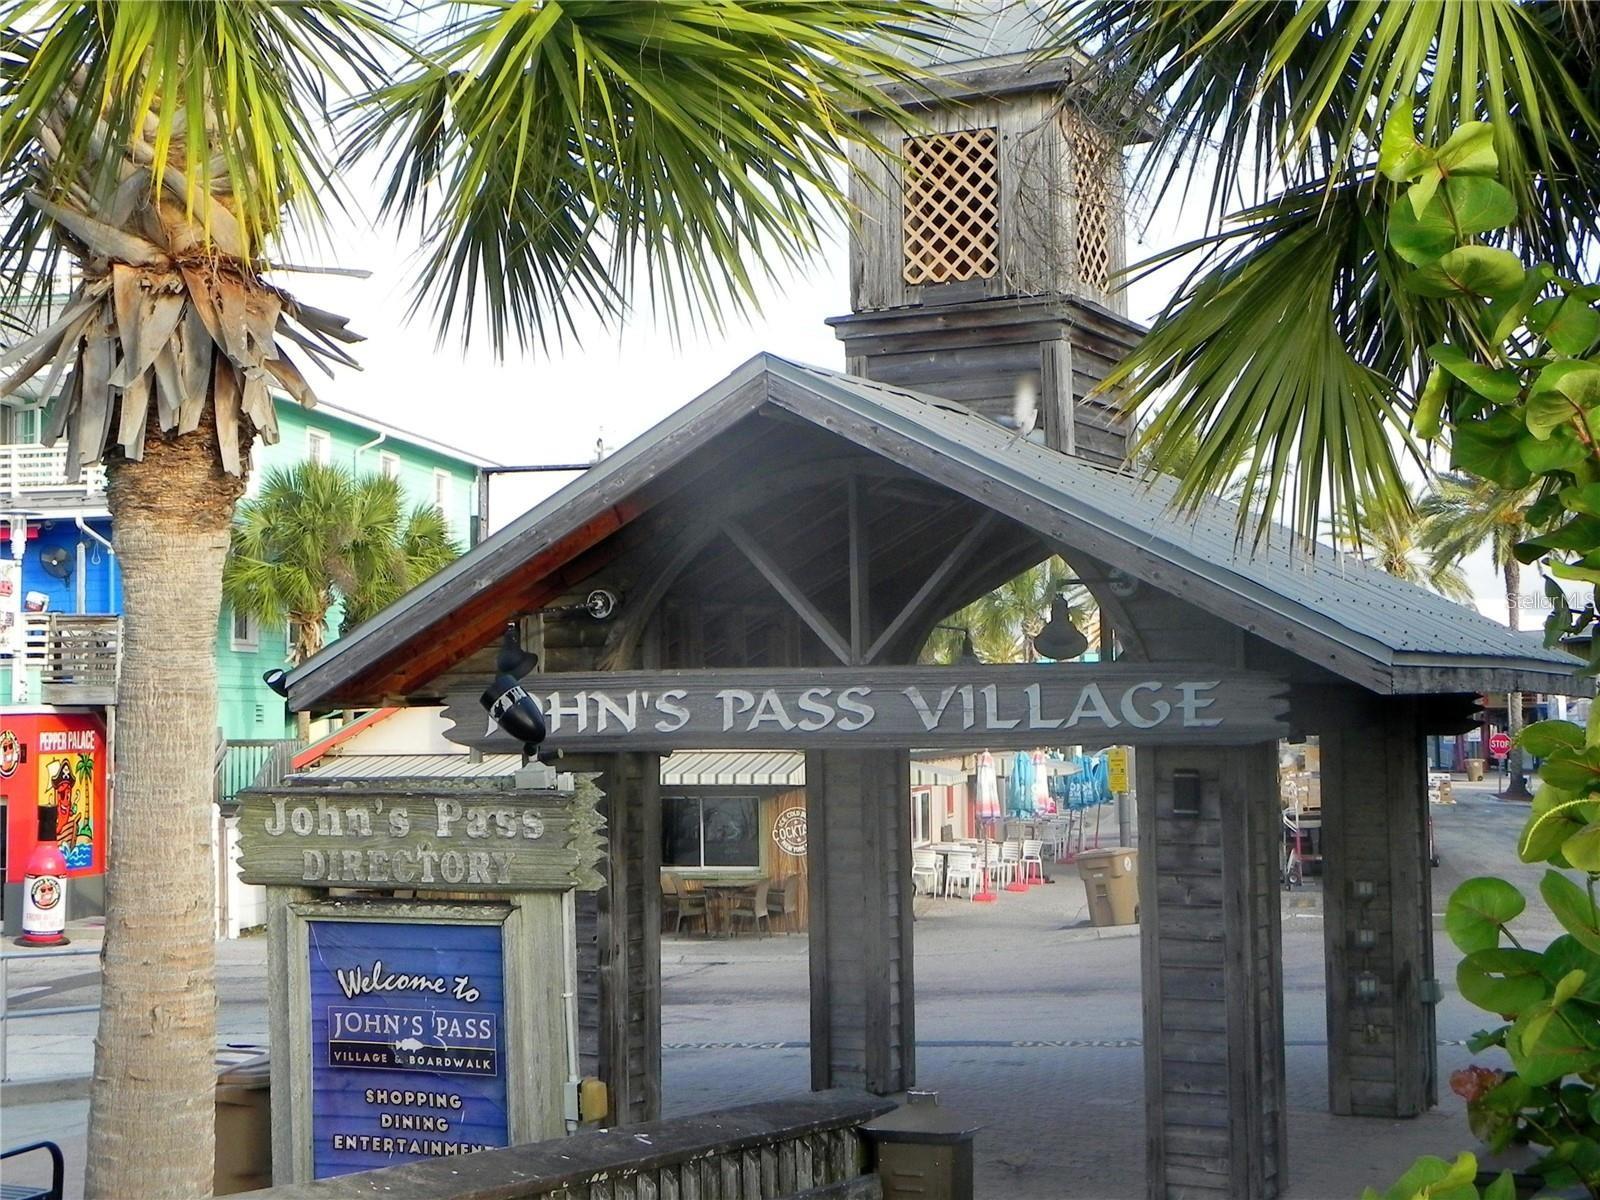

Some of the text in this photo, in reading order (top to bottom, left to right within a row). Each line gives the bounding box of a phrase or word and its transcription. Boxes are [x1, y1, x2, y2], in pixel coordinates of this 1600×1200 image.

[484, 681, 1224, 737] HN'S PASS VILLAGE
[39, 730, 96, 751] PEPPER PALACE
[1490, 739, 1510, 749] STOP
[264, 796, 544, 840] John's Pass
[772, 823, 807, 841] COCKTA
[302, 846, 516, 884] DIRECTORY
[337, 960, 481, 1003] Welcome to
[334, 1011, 492, 1040] JOHN'S PASS
[333, 1051, 492, 1070] VILLAGE & BOARDWALK
[365, 1088, 462, 1109] SHOPPING
[381, 1113, 449, 1132] DINING
